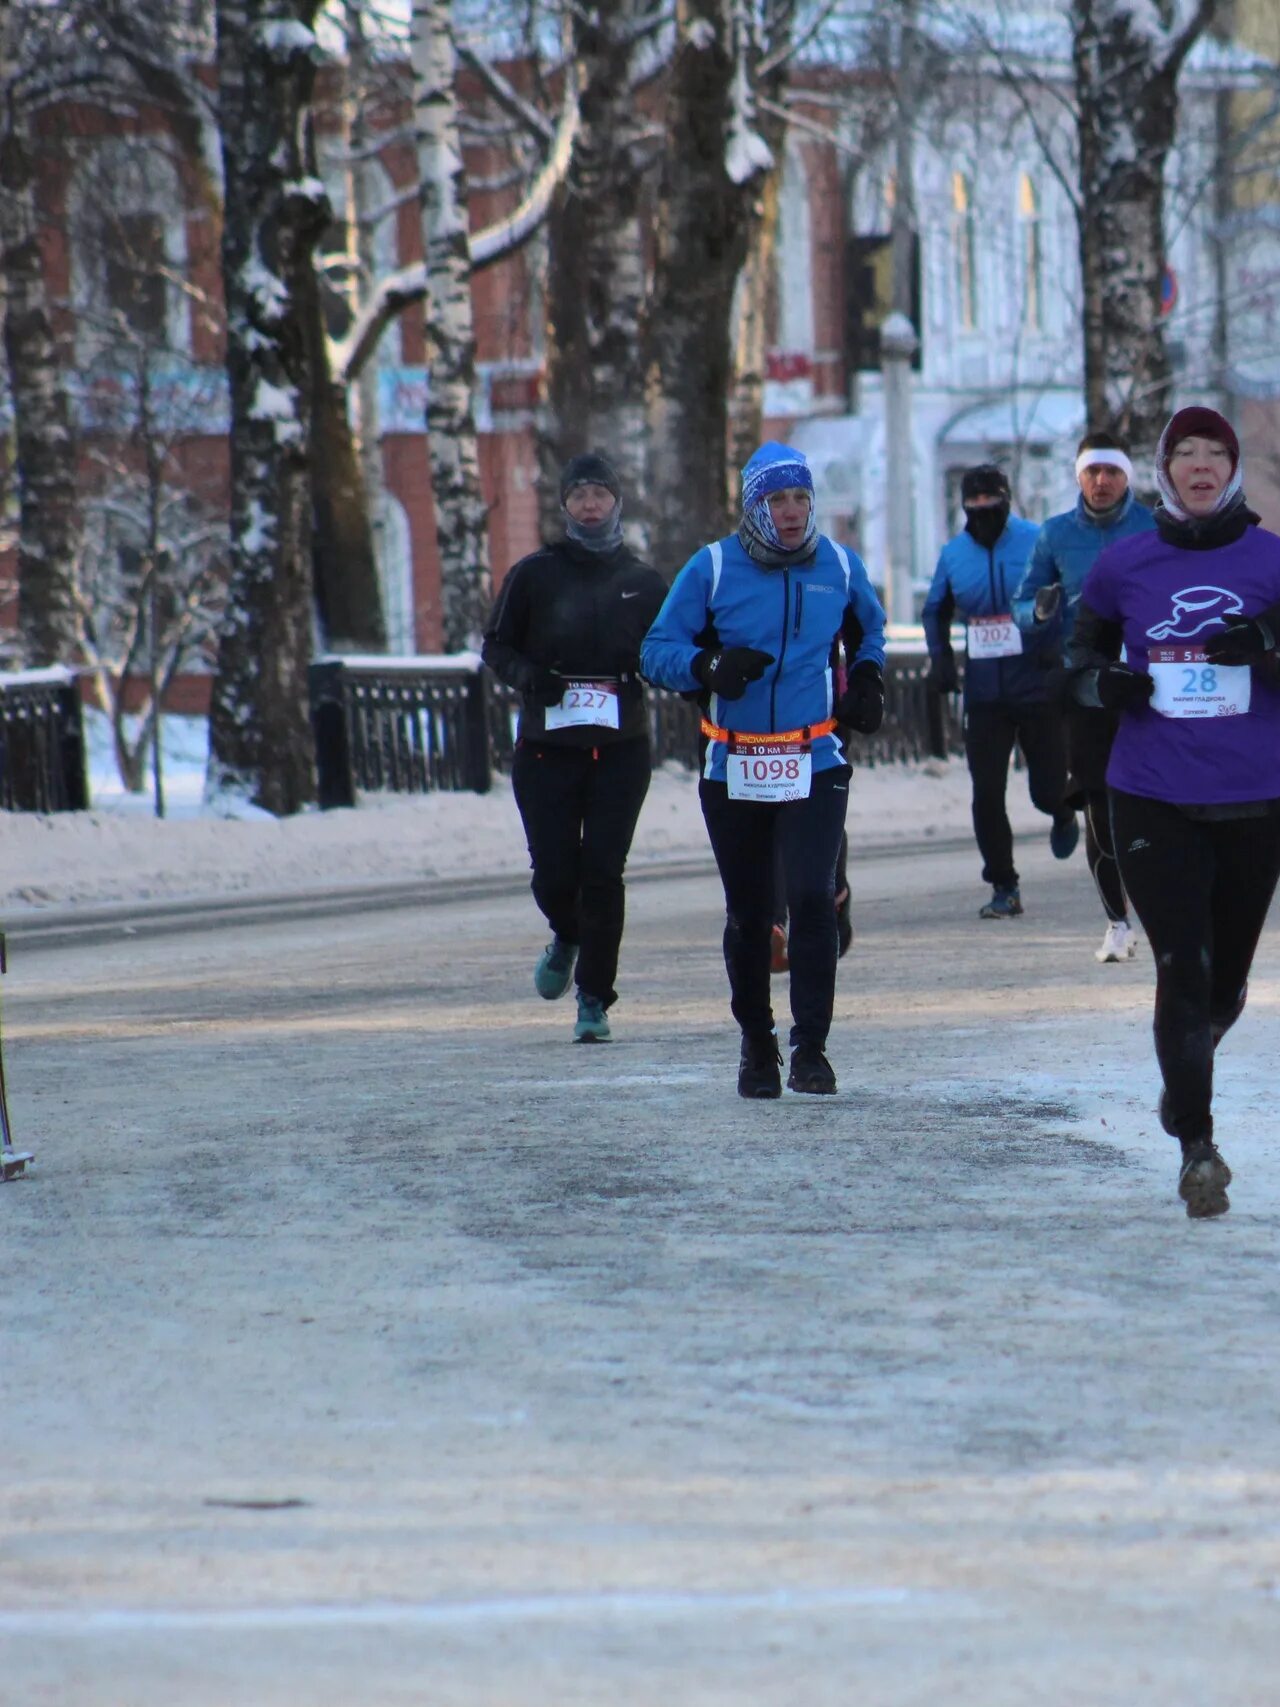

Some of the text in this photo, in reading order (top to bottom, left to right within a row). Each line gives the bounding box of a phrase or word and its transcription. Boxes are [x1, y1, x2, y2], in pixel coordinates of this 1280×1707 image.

[1184, 651, 1192, 660] 5
[1181, 668, 1217, 693] 28
[752, 746, 765, 754] 10
[740, 759, 800, 781] 1098
